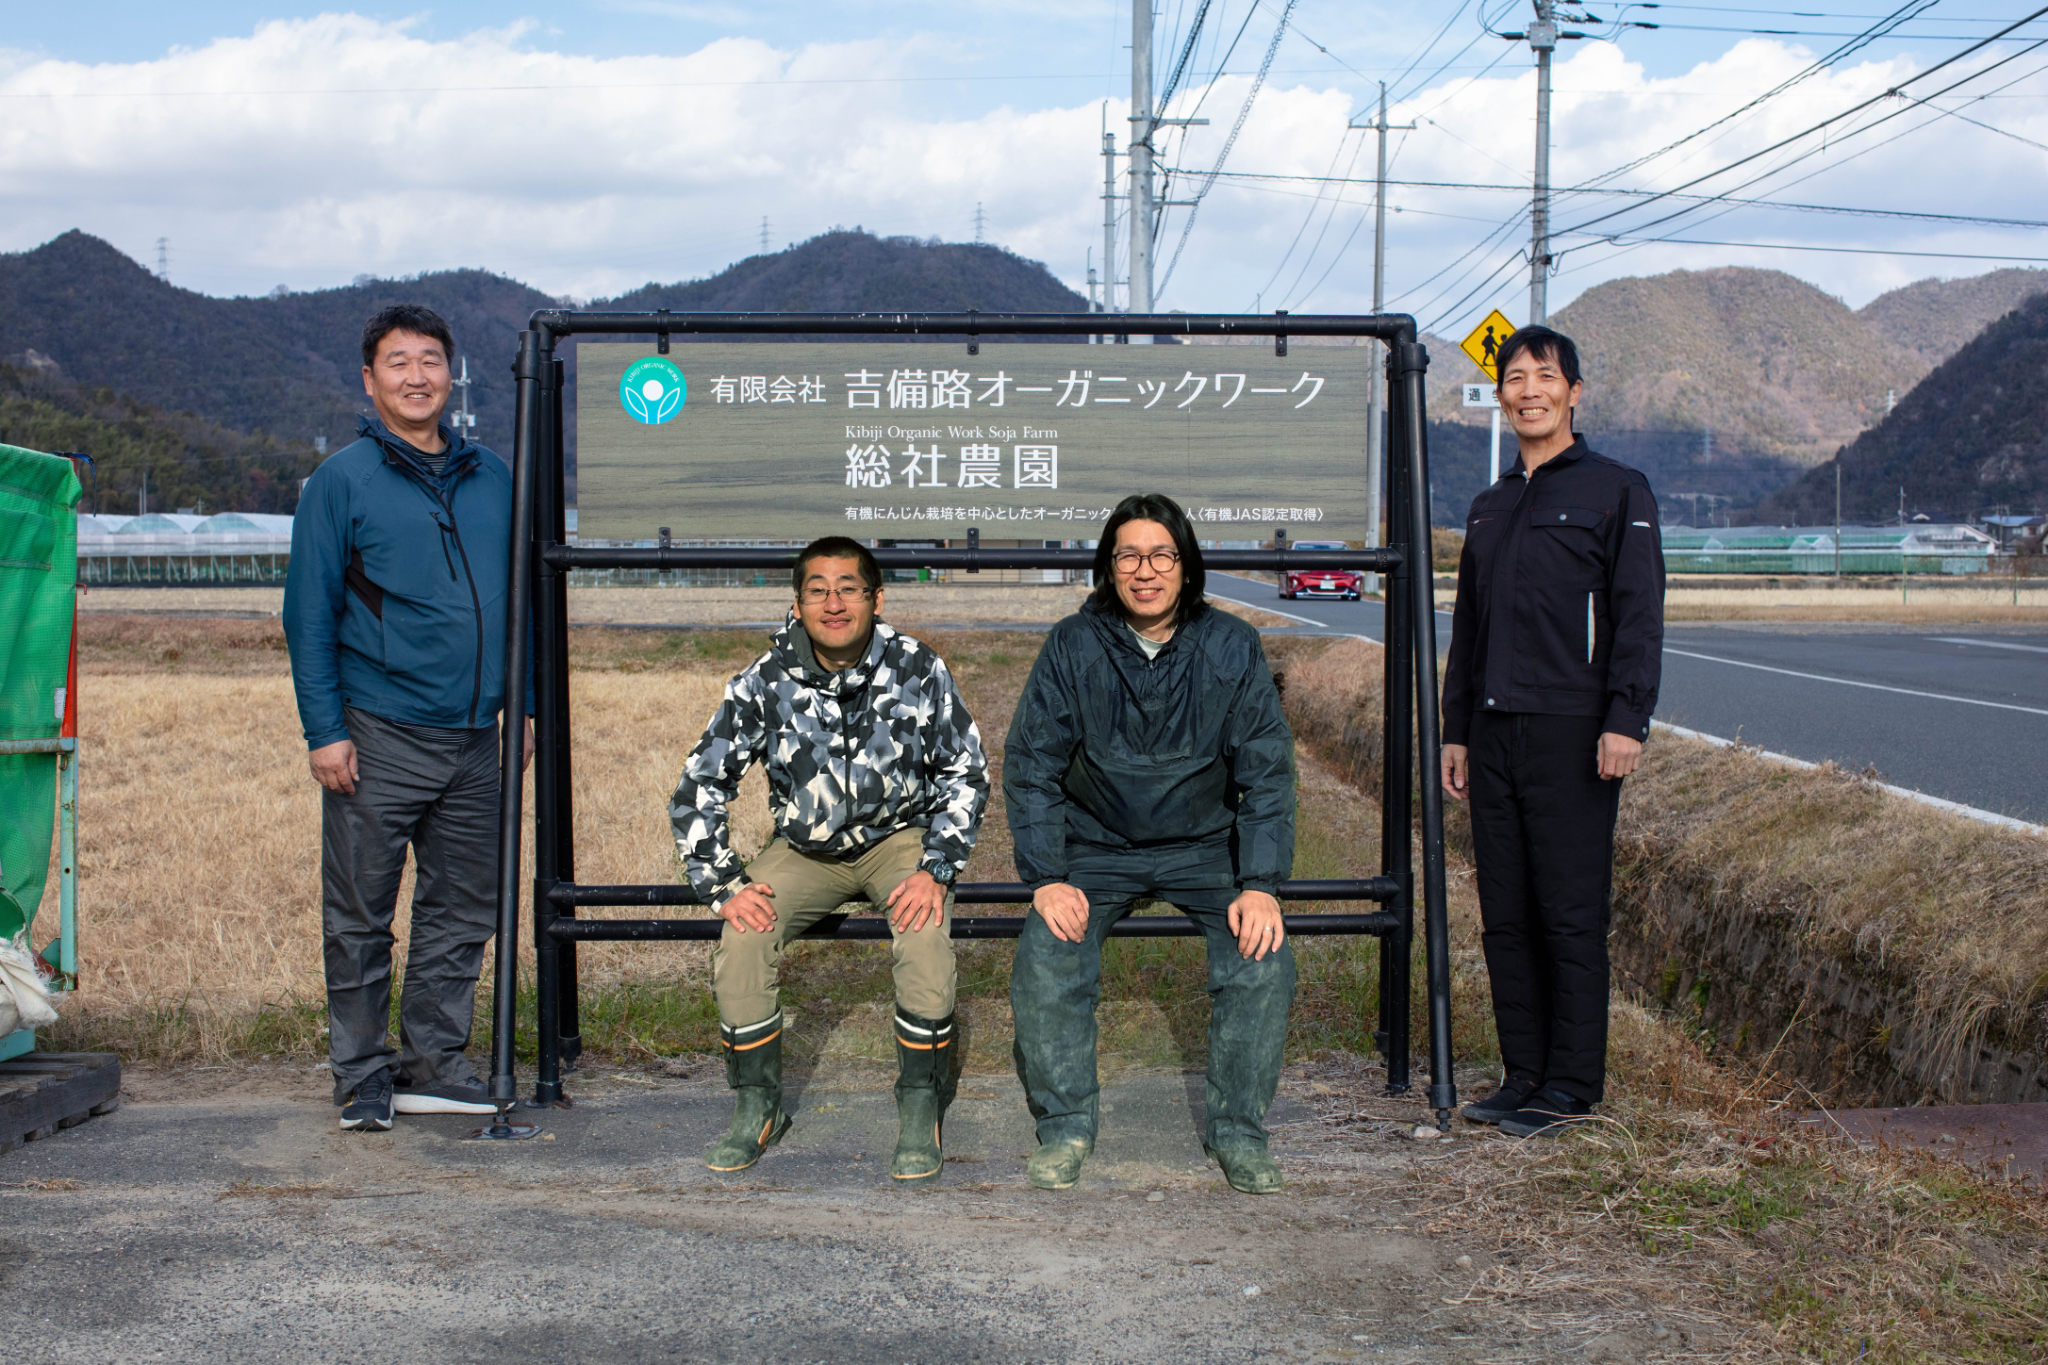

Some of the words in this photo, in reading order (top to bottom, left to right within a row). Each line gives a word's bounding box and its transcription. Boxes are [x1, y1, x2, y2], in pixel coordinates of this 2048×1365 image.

[710, 374, 827, 404] 有限会社
[844, 368, 1325, 410] 吉備路オーガニックワーク
[845, 425, 883, 442] Kibiji
[887, 425, 943, 442] Organic
[947, 425, 984, 439] Work
[988, 425, 1017, 442] Soja
[1023, 425, 1058, 439] Farm
[845, 443, 1058, 489] 総社農園
